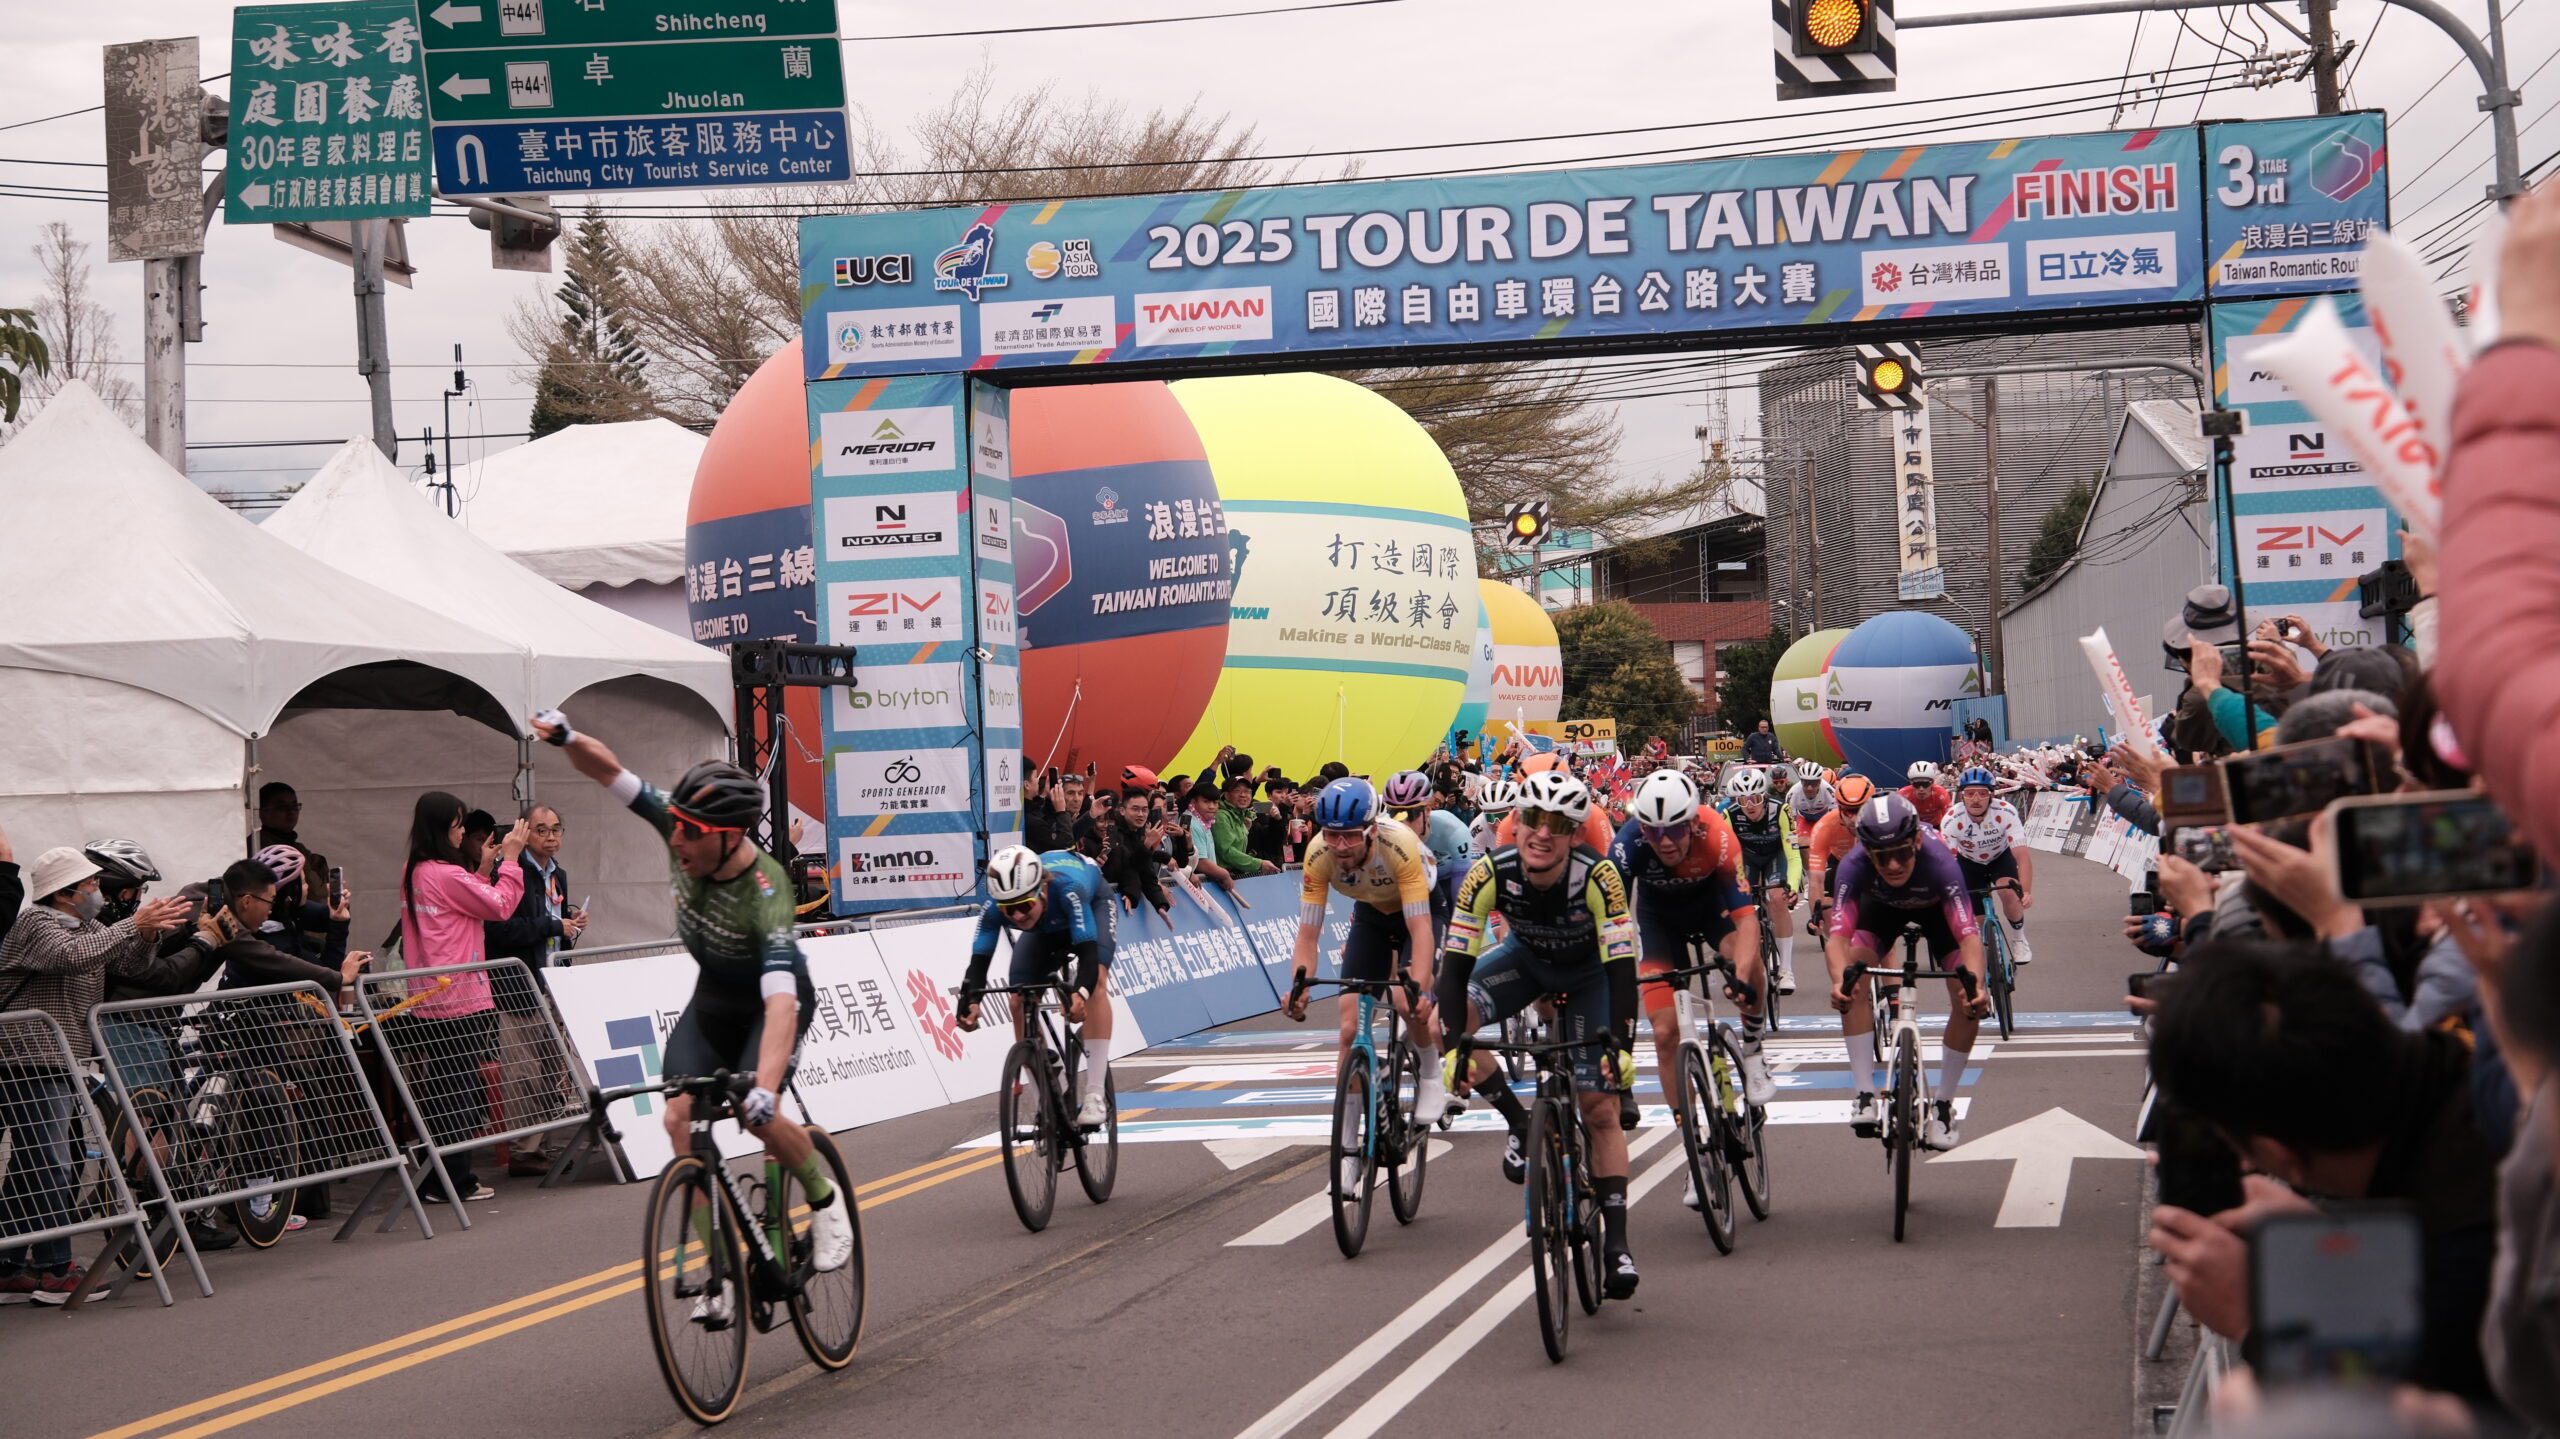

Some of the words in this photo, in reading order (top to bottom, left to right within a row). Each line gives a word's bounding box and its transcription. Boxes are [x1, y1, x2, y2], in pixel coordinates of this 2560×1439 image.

[655, 12, 767, 33] Shihcheng
[250, 17, 420, 70] 味味香
[583, 53, 614, 86] 卓
[781, 46, 812, 80] 蘭
[510, 75, 550, 95] 中44-1
[661, 92, 745, 110] Jhuolan
[241, 129, 422, 171] 30年客家料理店
[518, 120, 835, 164] 臺中市旅客服務中心
[523, 166, 591, 187] Taichung
[601, 164, 634, 184] City
[644, 162, 699, 181] Tourist
[708, 160, 769, 178] Service
[779, 157, 832, 175] Center
[2217, 144, 2285, 208] 3rd
[2259, 159, 2288, 174] STAGE
[2015, 165, 2177, 221] FINISH
[1148, 218, 1293, 269] 2025
[1305, 206, 1514, 270] TOUR
[1529, 199, 1633, 258] DE
[1653, 175, 1977, 252] TAIWAN
[1064, 240, 1089, 252] UCI
[1065, 253, 1091, 263] ASIA
[851, 256, 911, 284] UCI
[1064, 264, 1097, 277] TOUR
[1908, 260, 2001, 286] 台灣精品
[2040, 247, 2163, 282] 日立冷氣
[2224, 261, 2267, 281] Taiwan
[2270, 257, 2328, 277] Romantic
[2331, 257, 2361, 274] Rout
[936, 279, 961, 288] TOUR
[961, 278, 972, 287] DE
[972, 276, 1007, 287] TAIWAN
[1307, 262, 1817, 330] 國際自由車環台公路大賽
[1143, 298, 1264, 324] TAIWAN
[870, 320, 955, 339] 教育部體育署
[994, 325, 1102, 343] 經濟部國際貿易署
[1168, 325, 1196, 334] WAVES
[1198, 325, 1208, 333] OF
[1209, 322, 1242, 332] WONDER
[994, 343, 1035, 351] International
[1056, 339, 1103, 348] Administration
[841, 441, 935, 456] MERIDA
[2289, 432, 2324, 452] N
[875, 504, 906, 522] N
[846, 533, 937, 546] NOVATEC
[2256, 523, 2365, 551] ZIV
[1149, 555, 1208, 580] WELCOME
[1208, 554, 1219, 574] TO
[1326, 533, 1460, 582] 打造國際
[2256, 551, 2365, 569] 運動眼鏡
[688, 545, 816, 604] 浪漫台三線
[847, 591, 942, 617] ZIV
[985, 593, 1010, 616] ZIV
[1092, 589, 1156, 616] TAIWAN
[1160, 582, 1215, 606] ROMANTIC
[1321, 587, 1460, 630] 頂級賽會
[694, 616, 730, 641] WELCOME
[731, 613, 749, 635] TO
[848, 616, 943, 633] 運動眼鏡
[1278, 627, 1349, 645] Making
[1354, 634, 1365, 645] a
[1370, 631, 1452, 653] World-Class
[1453, 641, 1471, 656] Race
[877, 687, 949, 711] bryton
[1498, 693, 1527, 701] WAVES
[1527, 694, 1537, 702] OF
[1564, 723, 1595, 739] 50
[1598, 728, 1611, 737] m
[861, 786, 894, 799] SPORTS
[896, 784, 946, 797] GENERATOR
[828, 1046, 917, 1083] Administration
